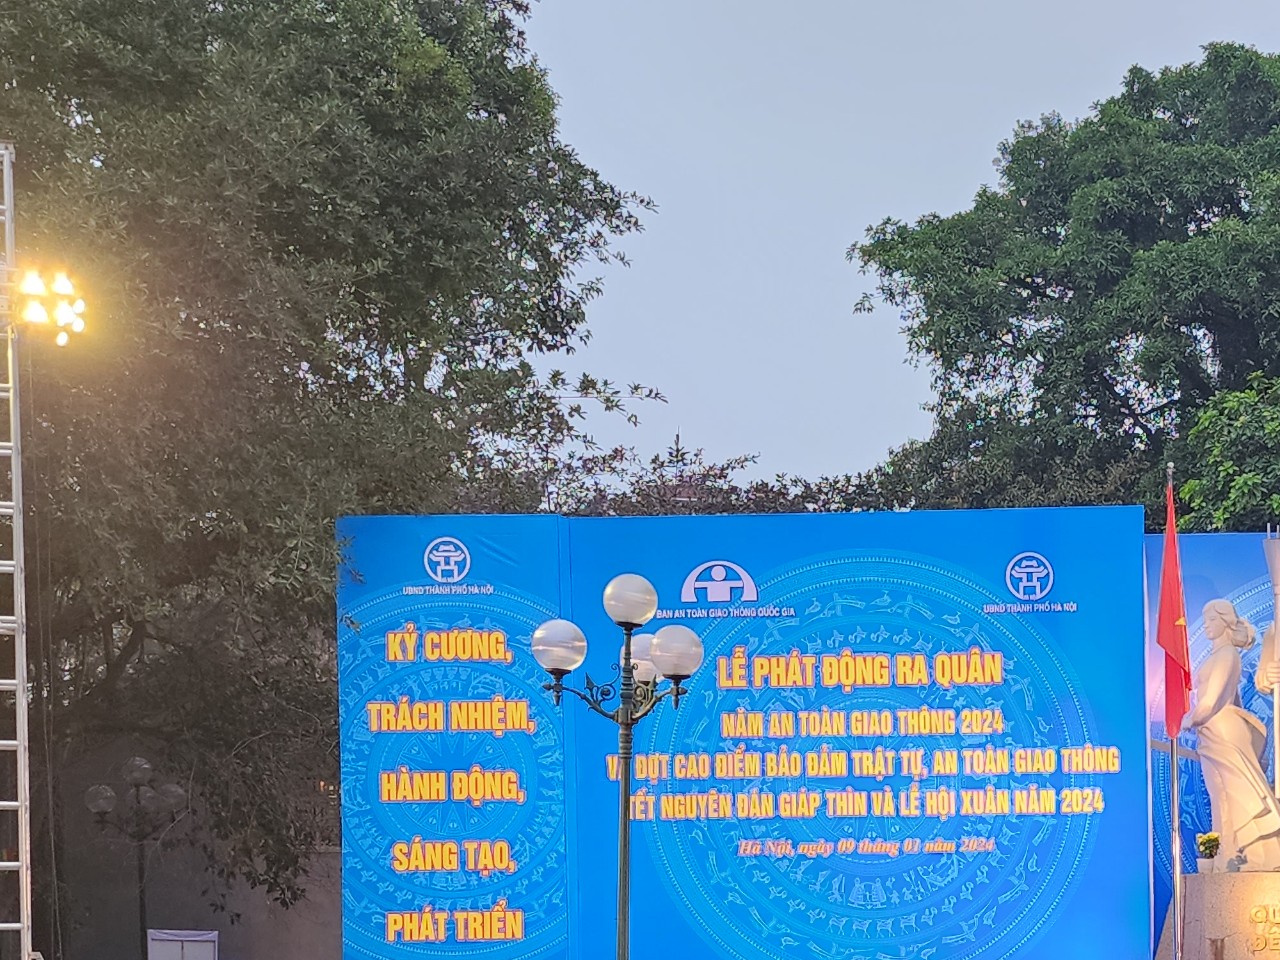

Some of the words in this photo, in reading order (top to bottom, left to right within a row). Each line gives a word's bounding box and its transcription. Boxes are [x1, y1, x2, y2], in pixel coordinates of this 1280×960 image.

[656, 609, 672, 618] BAN
[674, 609, 685, 618] AN
[686, 607, 707, 618] TOÀN
[708, 608, 728, 617] GIAO
[730, 606, 756, 617] THÔNG
[758, 604, 779, 617] QUỐC
[781, 607, 795, 616] GIA
[983, 603, 1006, 613] UBND
[1007, 602, 1032, 613] THÀNH
[1034, 601, 1050, 612] PHỐ
[1051, 602, 1062, 611] HÀ
[1063, 601, 1077, 613] NỘI
[387, 622, 418, 661] KỶ
[425, 629, 513, 663] CƯƠNG,
[718, 645, 747, 688] LỄ
[753, 648, 816, 687] PHÁT
[821, 647, 889, 693] ĐỘNG
[895, 655, 928, 686] RA
[934, 646, 1002, 689] QUÂN
[367, 696, 444, 732] TRÁCH
[451, 694, 535, 736] NHIỆM,
[721, 707, 763, 738] NĂM
[768, 711, 793, 736] AN
[799, 705, 845, 736] TOÀN
[850, 710, 893, 735] GIAO
[897, 705, 956, 735] THÔNG
[961, 709, 1004, 734] 2024
[636, 752, 669, 784] ĐỢT
[674, 754, 711, 779] CAO
[715, 742, 762, 779] ĐIỂM
[766, 744, 801, 777] BẢO
[806, 743, 847, 776] ĐẢM
[852, 746, 896, 781] TRẬT
[899, 750, 928, 780] TỰ,
[933, 750, 958, 775] AN
[962, 743, 1009, 774] TOÀN
[1014, 749, 1056, 773] GIAO
[1062, 742, 1120, 773] THÔNG
[380, 766, 446, 801] HÀNH
[453, 765, 525, 806] ĐỘNG,
[661, 788, 733, 819] NGUYÊN
[737, 787, 774, 818] ĐÁN
[779, 787, 820, 818] GIÁP
[826, 786, 867, 817] THÌN
[871, 786, 895, 816] VÀ
[898, 783, 921, 816] LỄ
[925, 786, 955, 820] HỘI
[960, 785, 1009, 815] XUÂN
[1014, 783, 1056, 814] NĂM
[1060, 787, 1105, 814] 2024
[392, 836, 458, 871] SÁNG
[464, 841, 516, 877] TẠO,
[738, 839, 761, 856] Hà
[766, 839, 795, 857] Nội,
[798, 840, 832, 857] ngày
[838, 839, 855, 853] 09
[858, 838, 898, 857] tháng
[903, 838, 920, 853] 01
[925, 838, 956, 853] năm
[960, 837, 996, 852] 2024
[386, 905, 448, 941] PHÁT
[454, 898, 524, 940] TRIỂN
